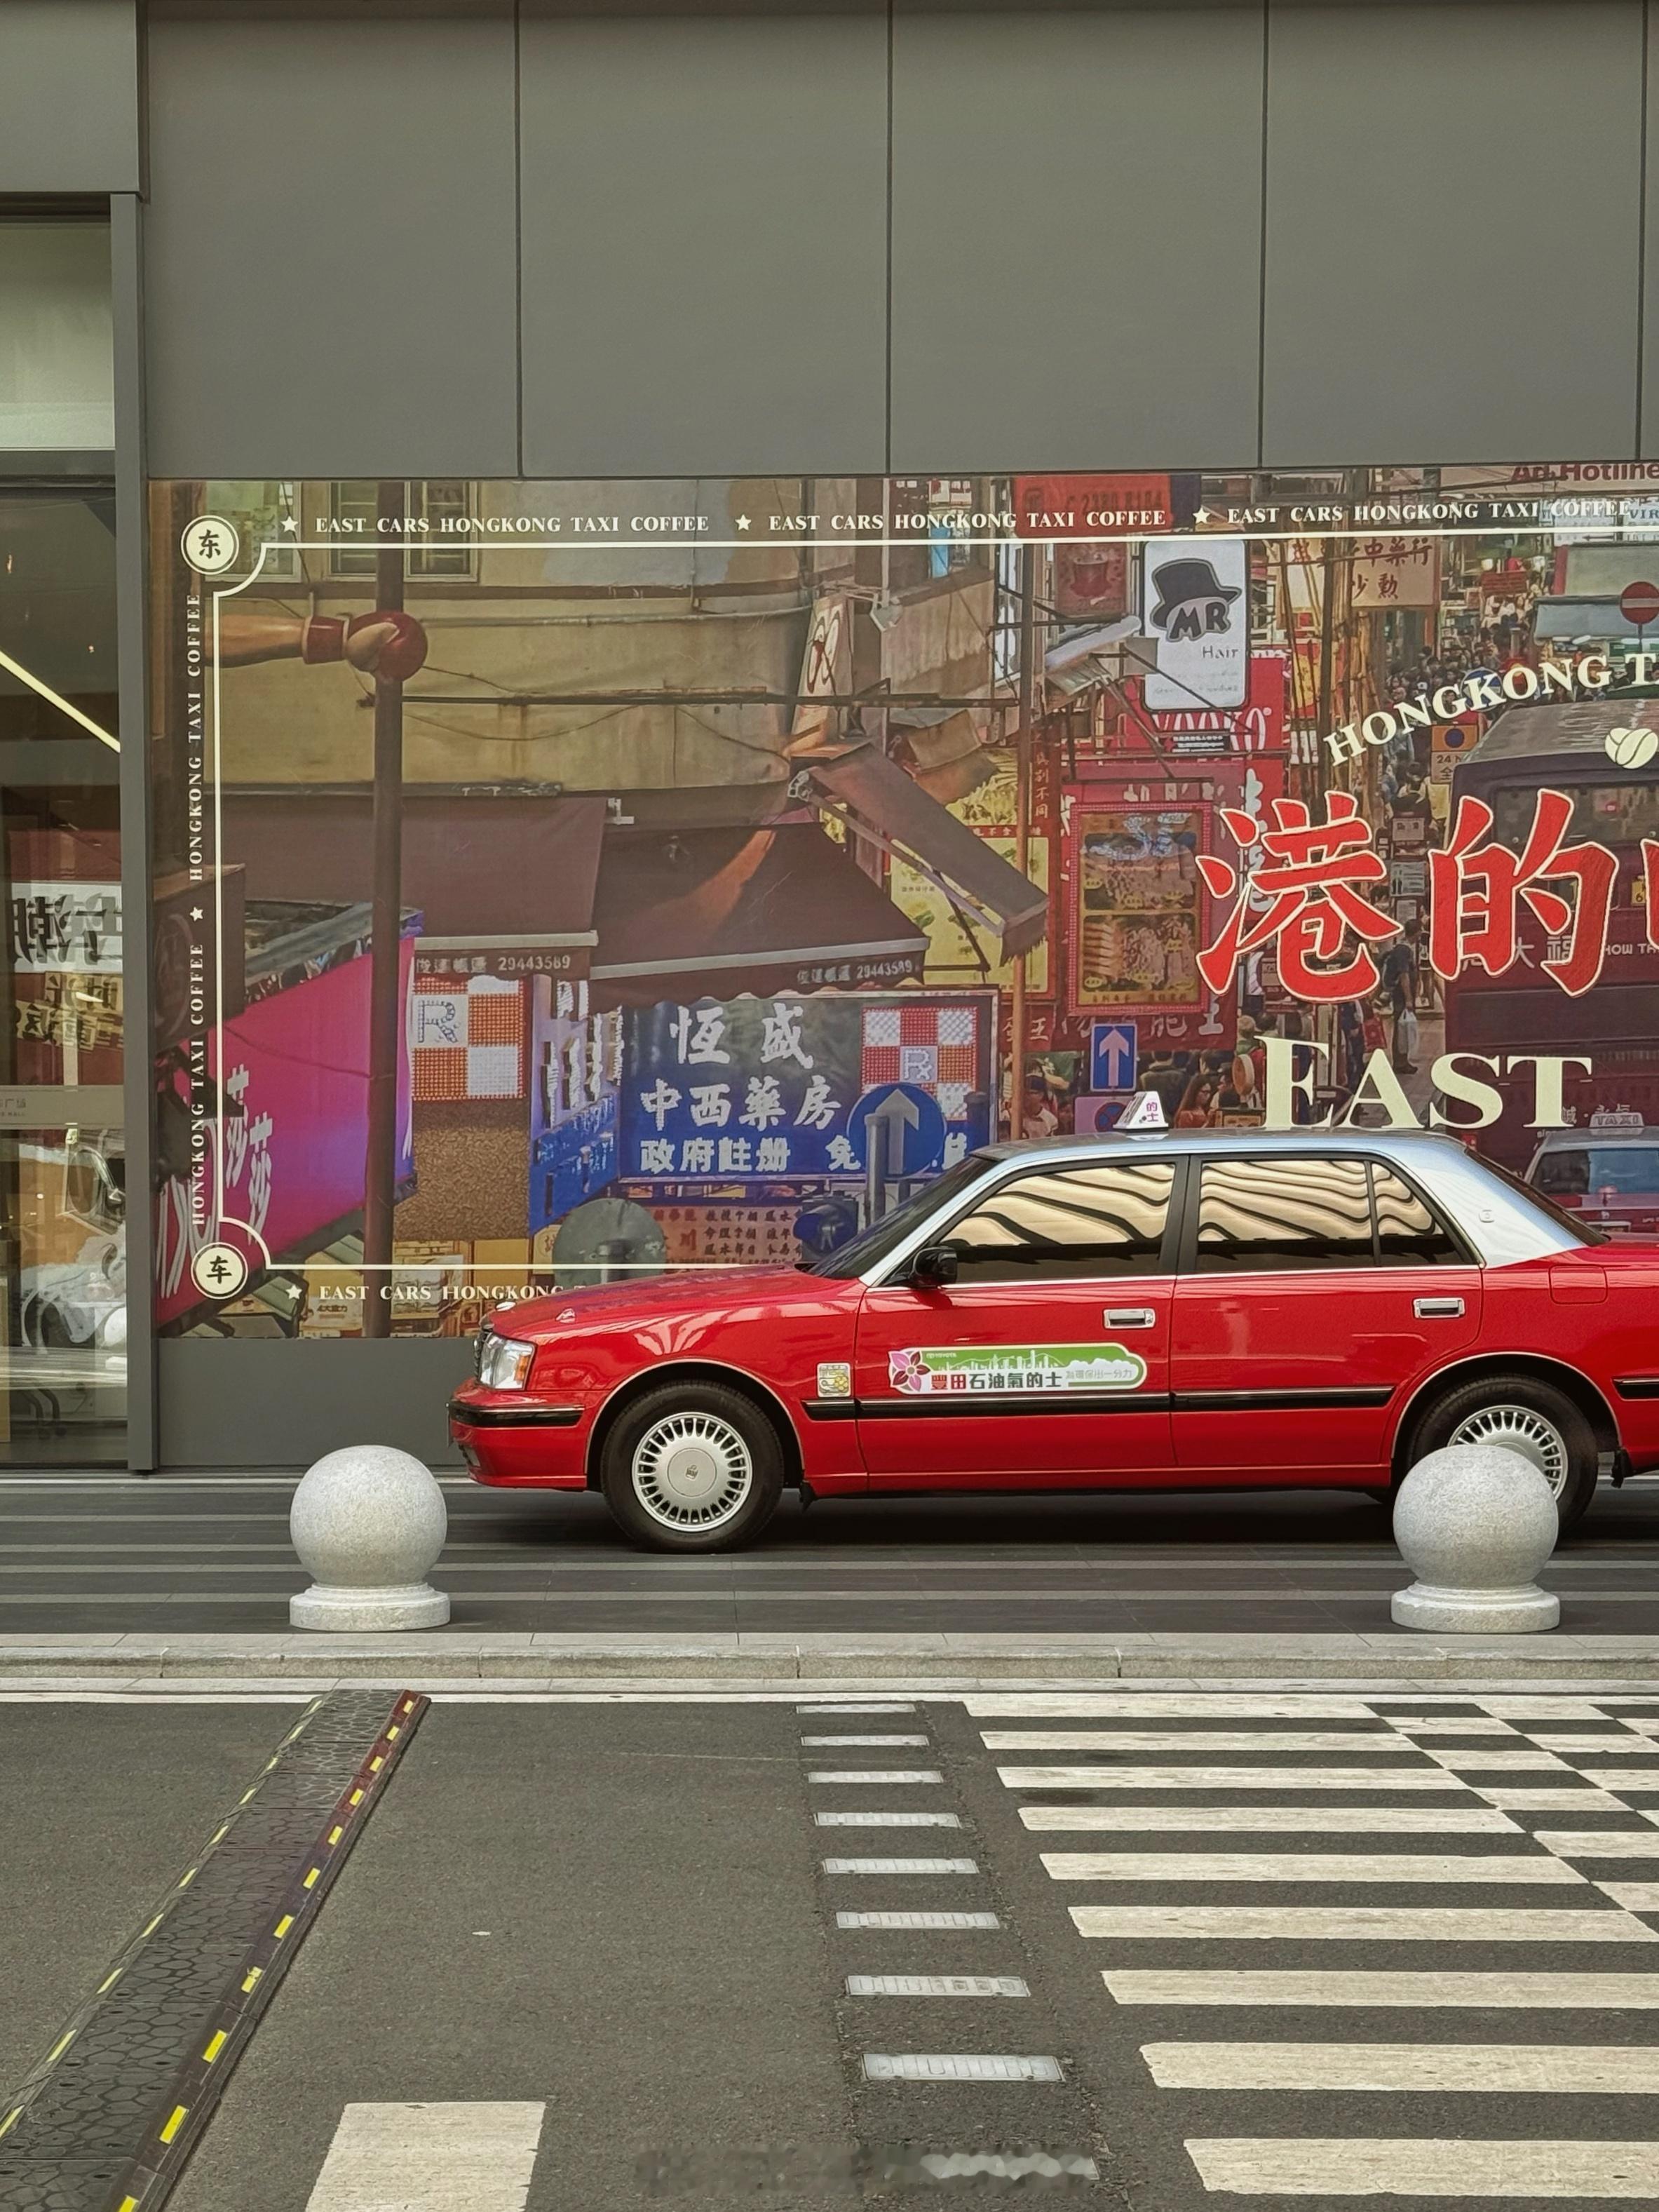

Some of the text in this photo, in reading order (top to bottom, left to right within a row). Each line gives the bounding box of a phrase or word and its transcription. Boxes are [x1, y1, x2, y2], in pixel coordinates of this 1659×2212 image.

[316, 515, 709, 533] EAST CARS HONGKONG TAXI COFFEE
[769, 510, 1166, 531] EAST CARS HONGKONG TAXI COFFEE
[1228, 507, 1280, 524] EAST
[1290, 506, 1343, 522] CARS
[1354, 503, 1479, 521] HONGKONG
[1488, 501, 1539, 519] TAXI
[1550, 500, 1632, 517] COFFEE
[198, 530, 222, 559] 东
[1167, 600, 1230, 642] MR
[1202, 645, 1239, 659] Hair
[1323, 653, 1659, 766] HONGKONG T
[187, 594, 203, 882] HONGKONG TAXI COFFEE
[1195, 788, 1659, 1003] 港的
[190, 944, 205, 1226] HONGKONG TAXI COFFEE
[1254, 1035, 1593, 1131] EAST
[640, 1074, 842, 1132] 中西藥房
[1145, 1102, 1159, 1122] 的士
[1593, 1114, 1640, 1126] TAXI
[206, 1255, 233, 1285] 车
[319, 1285, 370, 1300] EAST
[379, 1285, 432, 1300] CARS
[442, 1284, 564, 1300] HONGKONG
[930, 1371, 1063, 1391] 豐田石油氣的士
